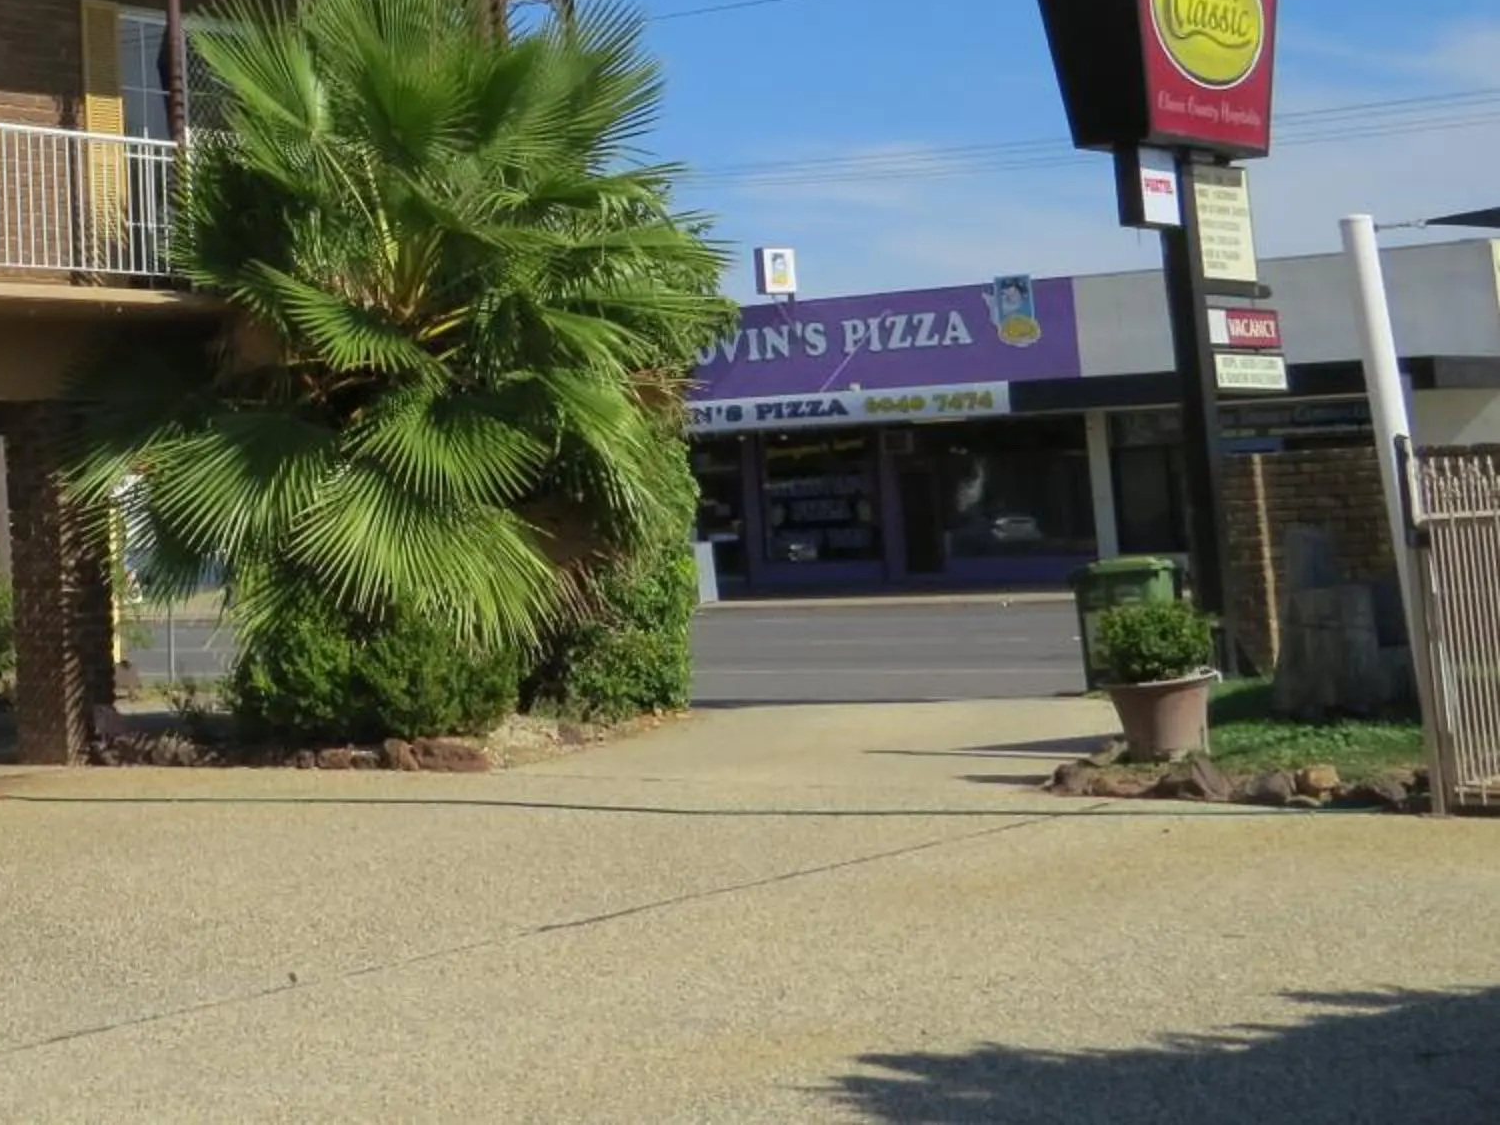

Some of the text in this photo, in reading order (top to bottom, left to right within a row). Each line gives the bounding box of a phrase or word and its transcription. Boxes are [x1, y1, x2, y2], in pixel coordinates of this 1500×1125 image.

[842, 311, 974, 354] PIZZA
[1227, 318, 1276, 338] VACANCY
[755, 398, 849, 421] PIZZA
